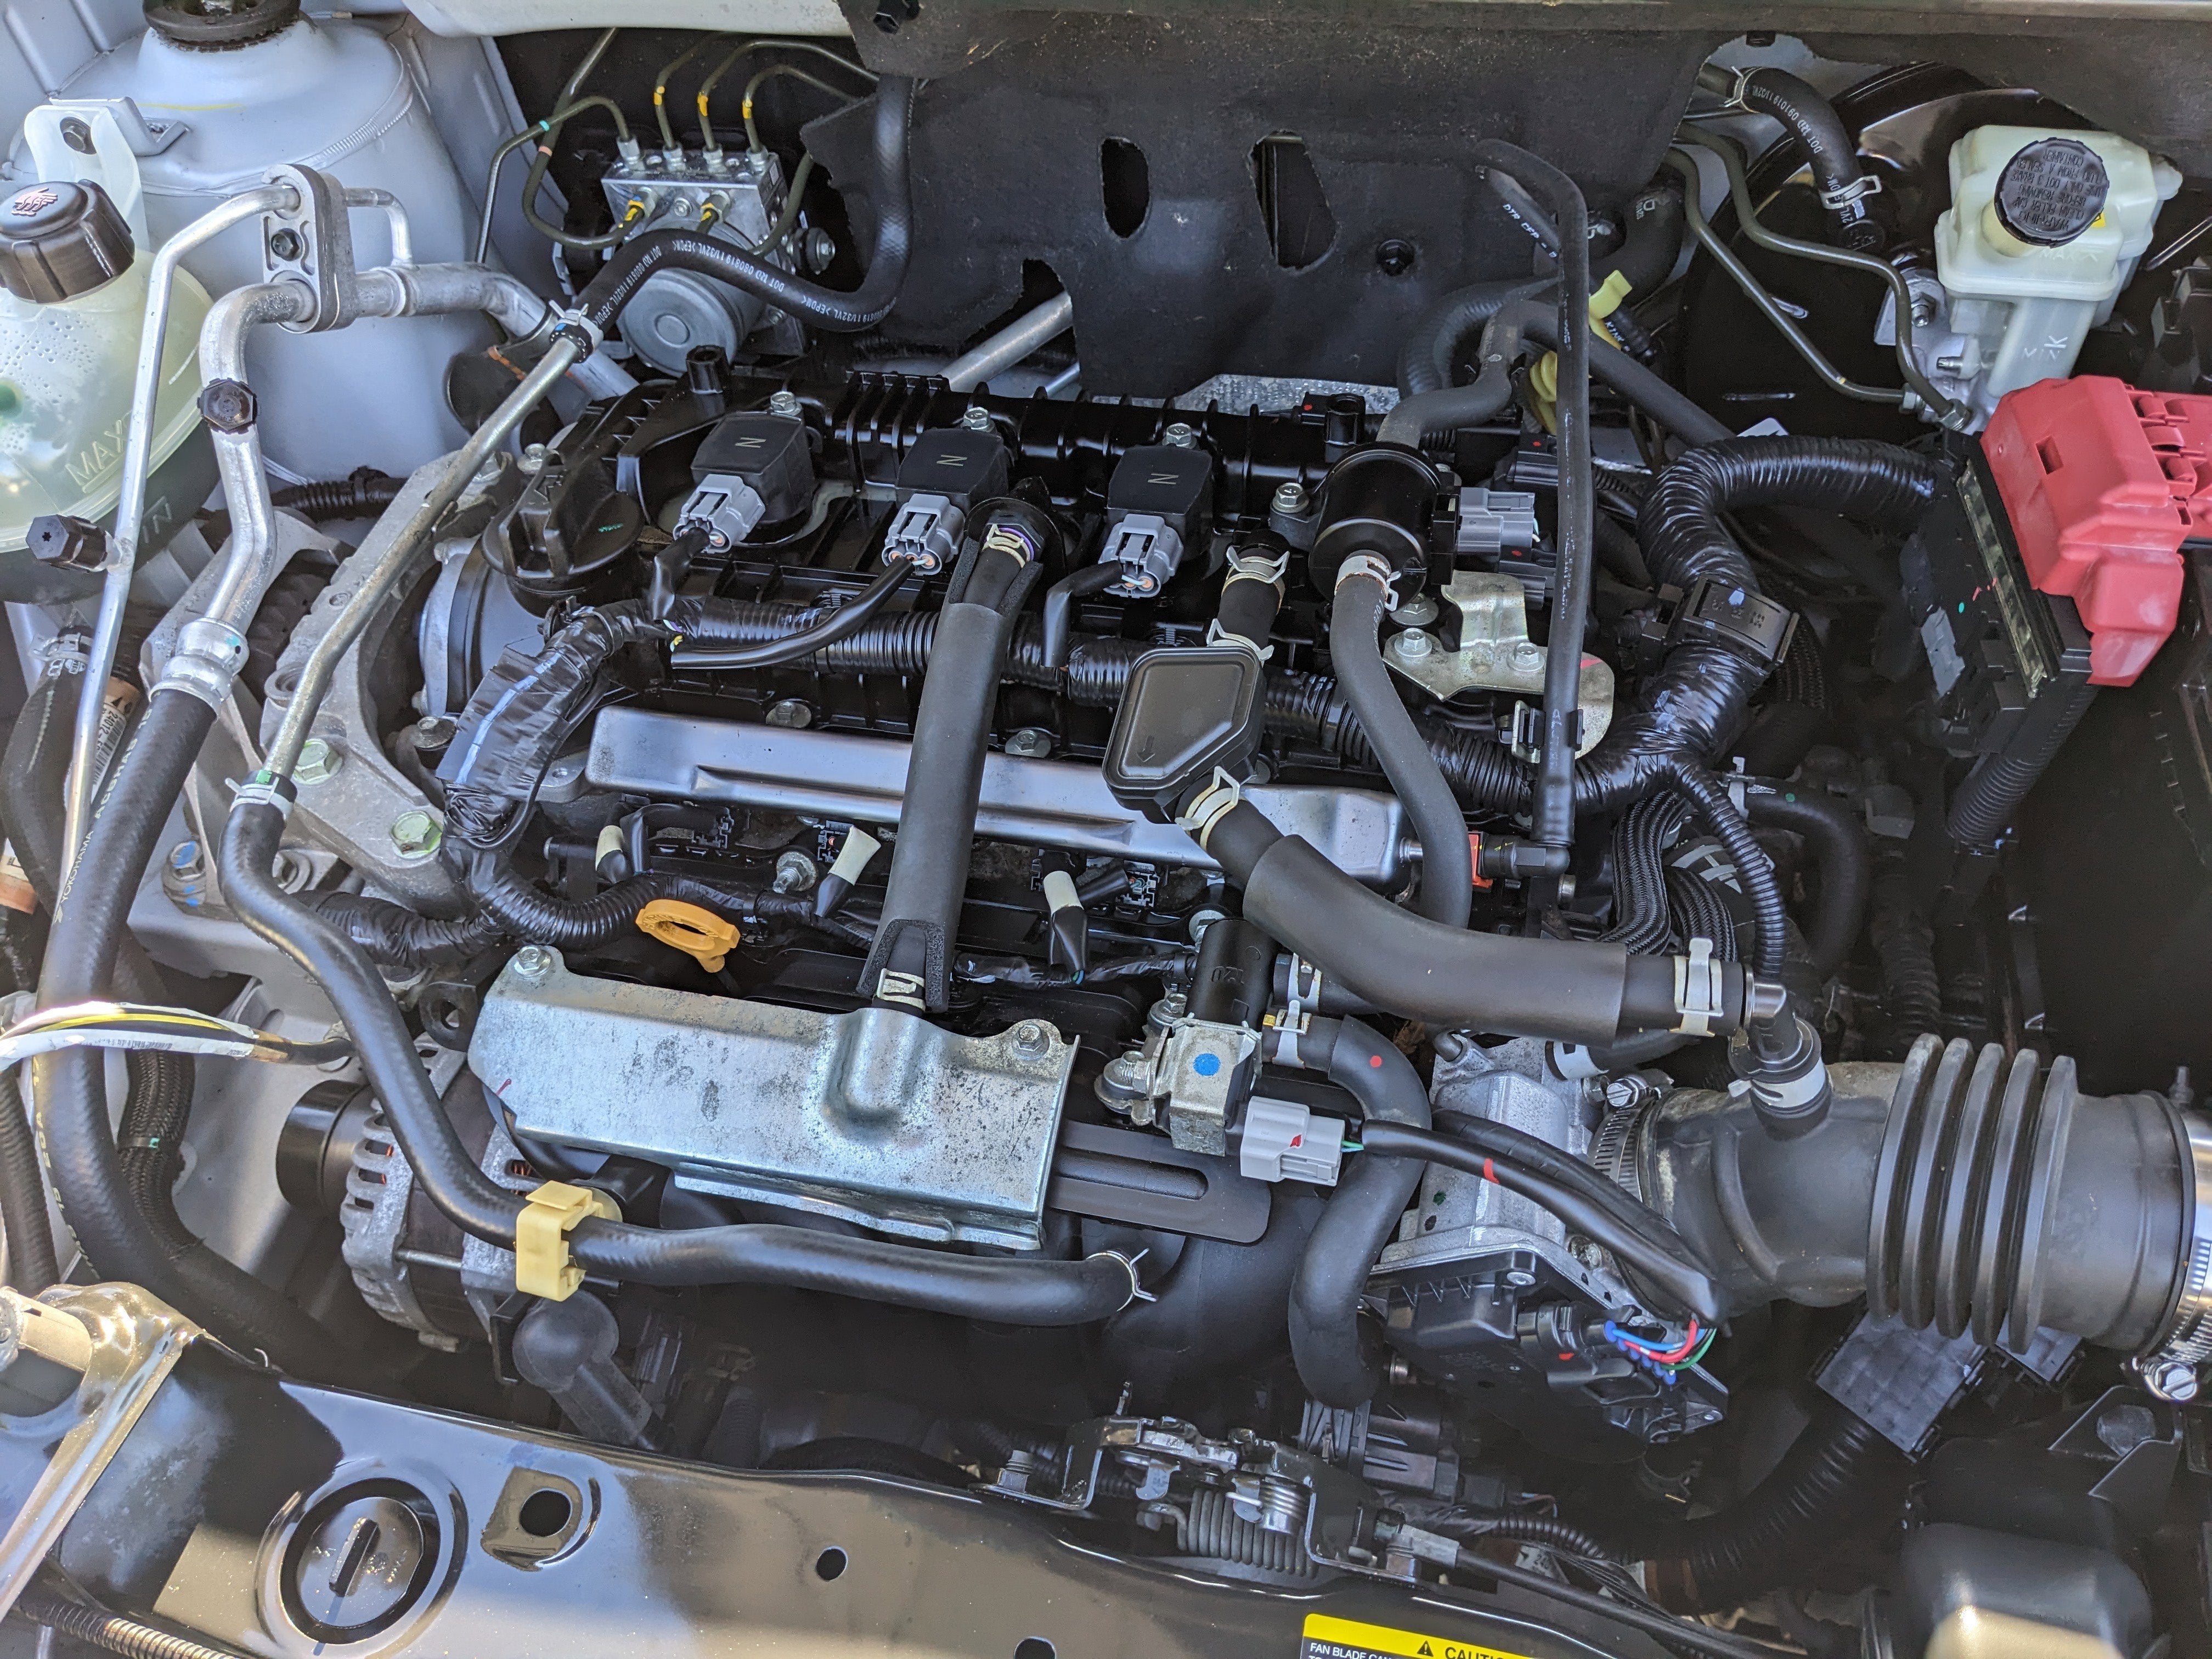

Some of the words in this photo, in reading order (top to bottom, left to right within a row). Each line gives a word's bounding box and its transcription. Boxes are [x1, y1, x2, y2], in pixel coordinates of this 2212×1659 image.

[1806, 135, 1824, 154] DOT
[2018, 210, 2069, 232] WARNING
[768, 277, 786, 292] DOT
[61, 831, 94, 902] YOKOHAMA
[1310, 1643, 1330, 1655] FAN
